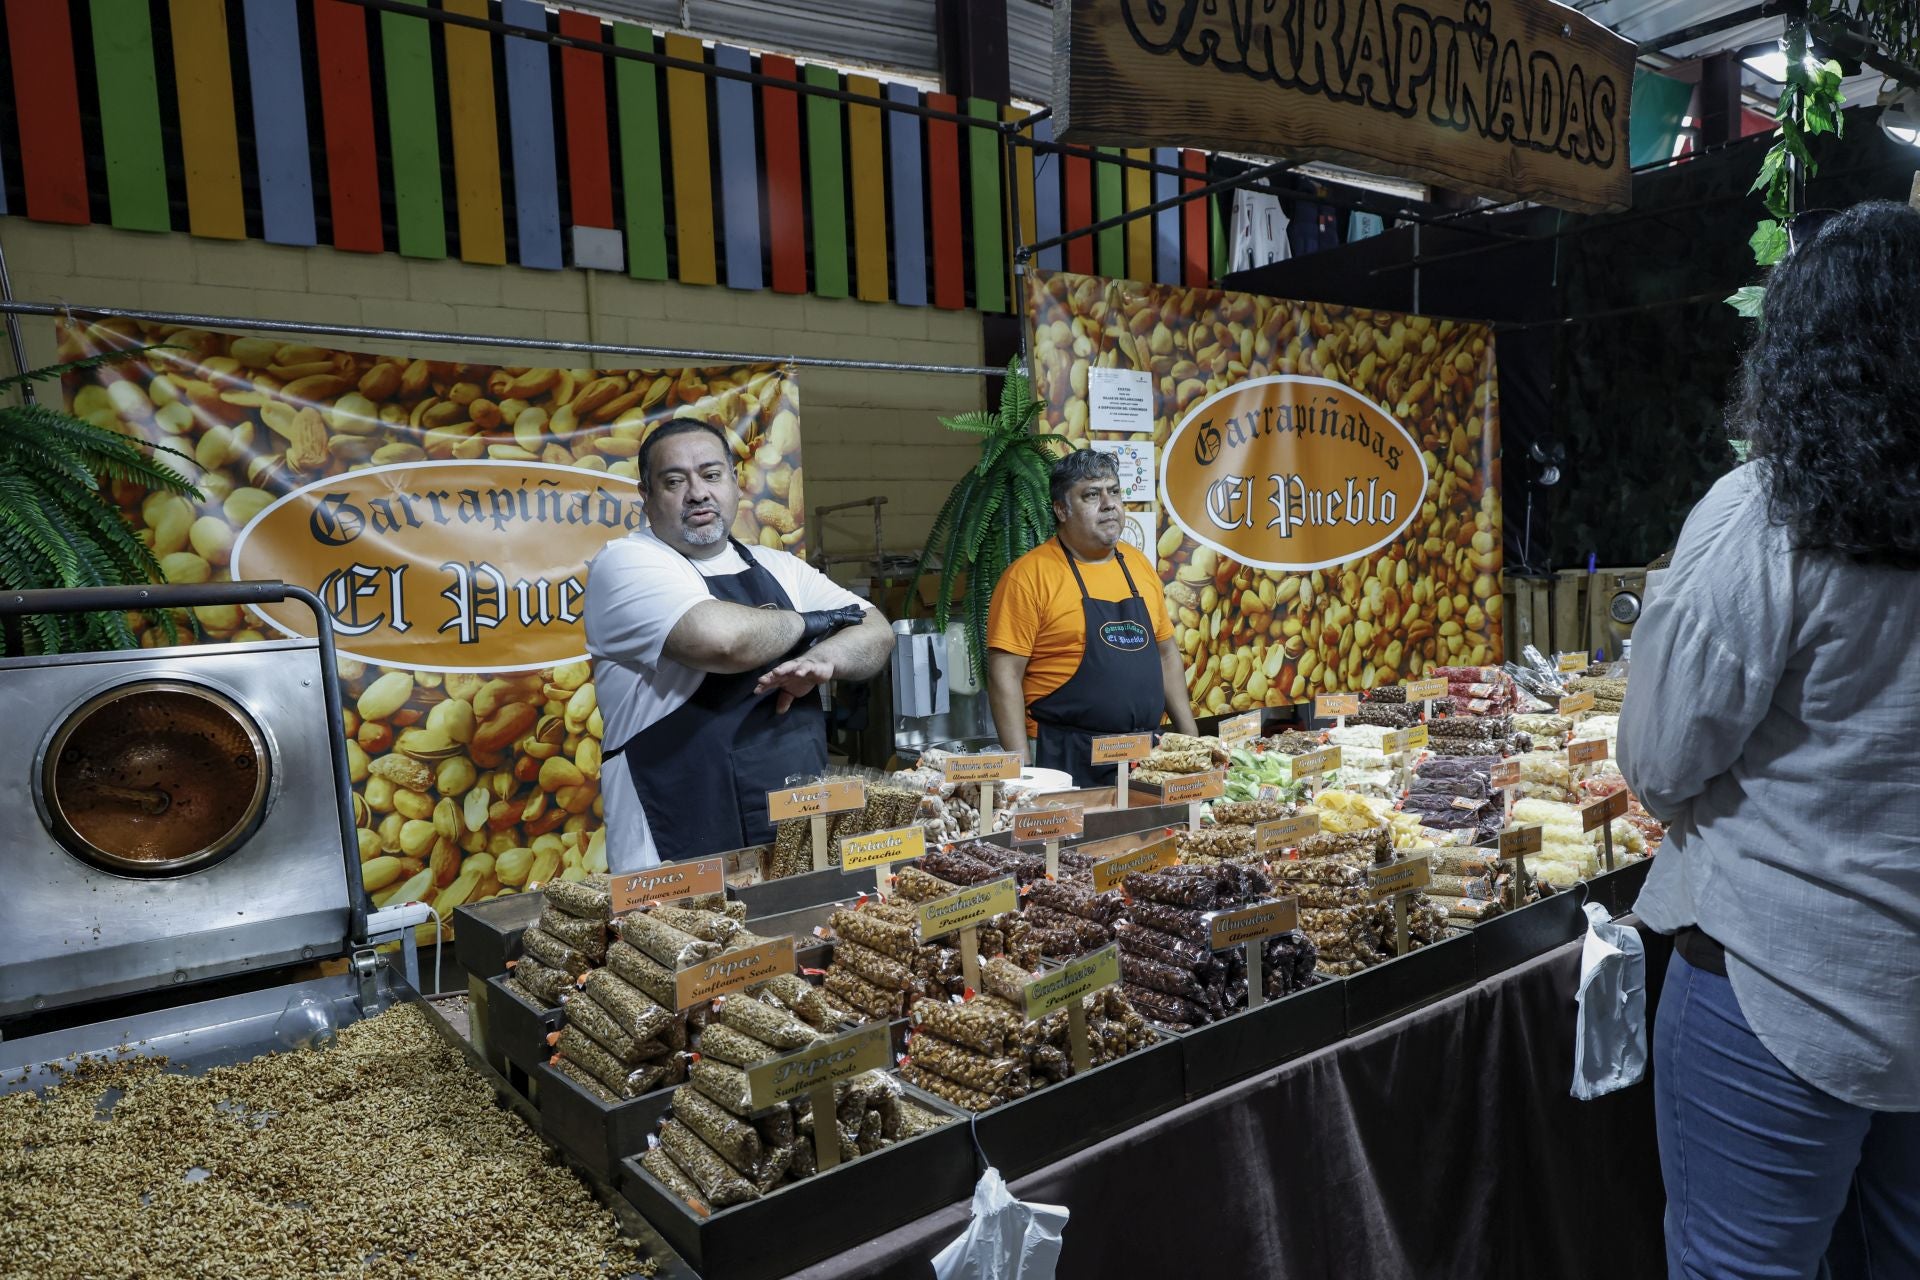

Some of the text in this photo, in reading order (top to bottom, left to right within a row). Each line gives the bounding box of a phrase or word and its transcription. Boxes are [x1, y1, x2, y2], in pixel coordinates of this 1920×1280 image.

[1195, 397, 1404, 471] Garrapiñadas
[309, 478, 648, 546] Garrapiñada
[1205, 474, 1398, 538] El Pueblo
[317, 560, 594, 644] El Pue
[798, 804, 820, 813] Nut
[848, 850, 902, 865] Pistachio
[624, 871, 686, 893] Pipas
[625, 886, 691, 906] Sunflower seed
[938, 908, 986, 928] Peanuts
[691, 964, 777, 999] Sunflower Seeds
[703, 952, 760, 980] Pipas
[1045, 983, 1092, 1008] Peanuts
[772, 1046, 858, 1084] Pipas
[774, 1063, 857, 1098] Sunflower Seeds
